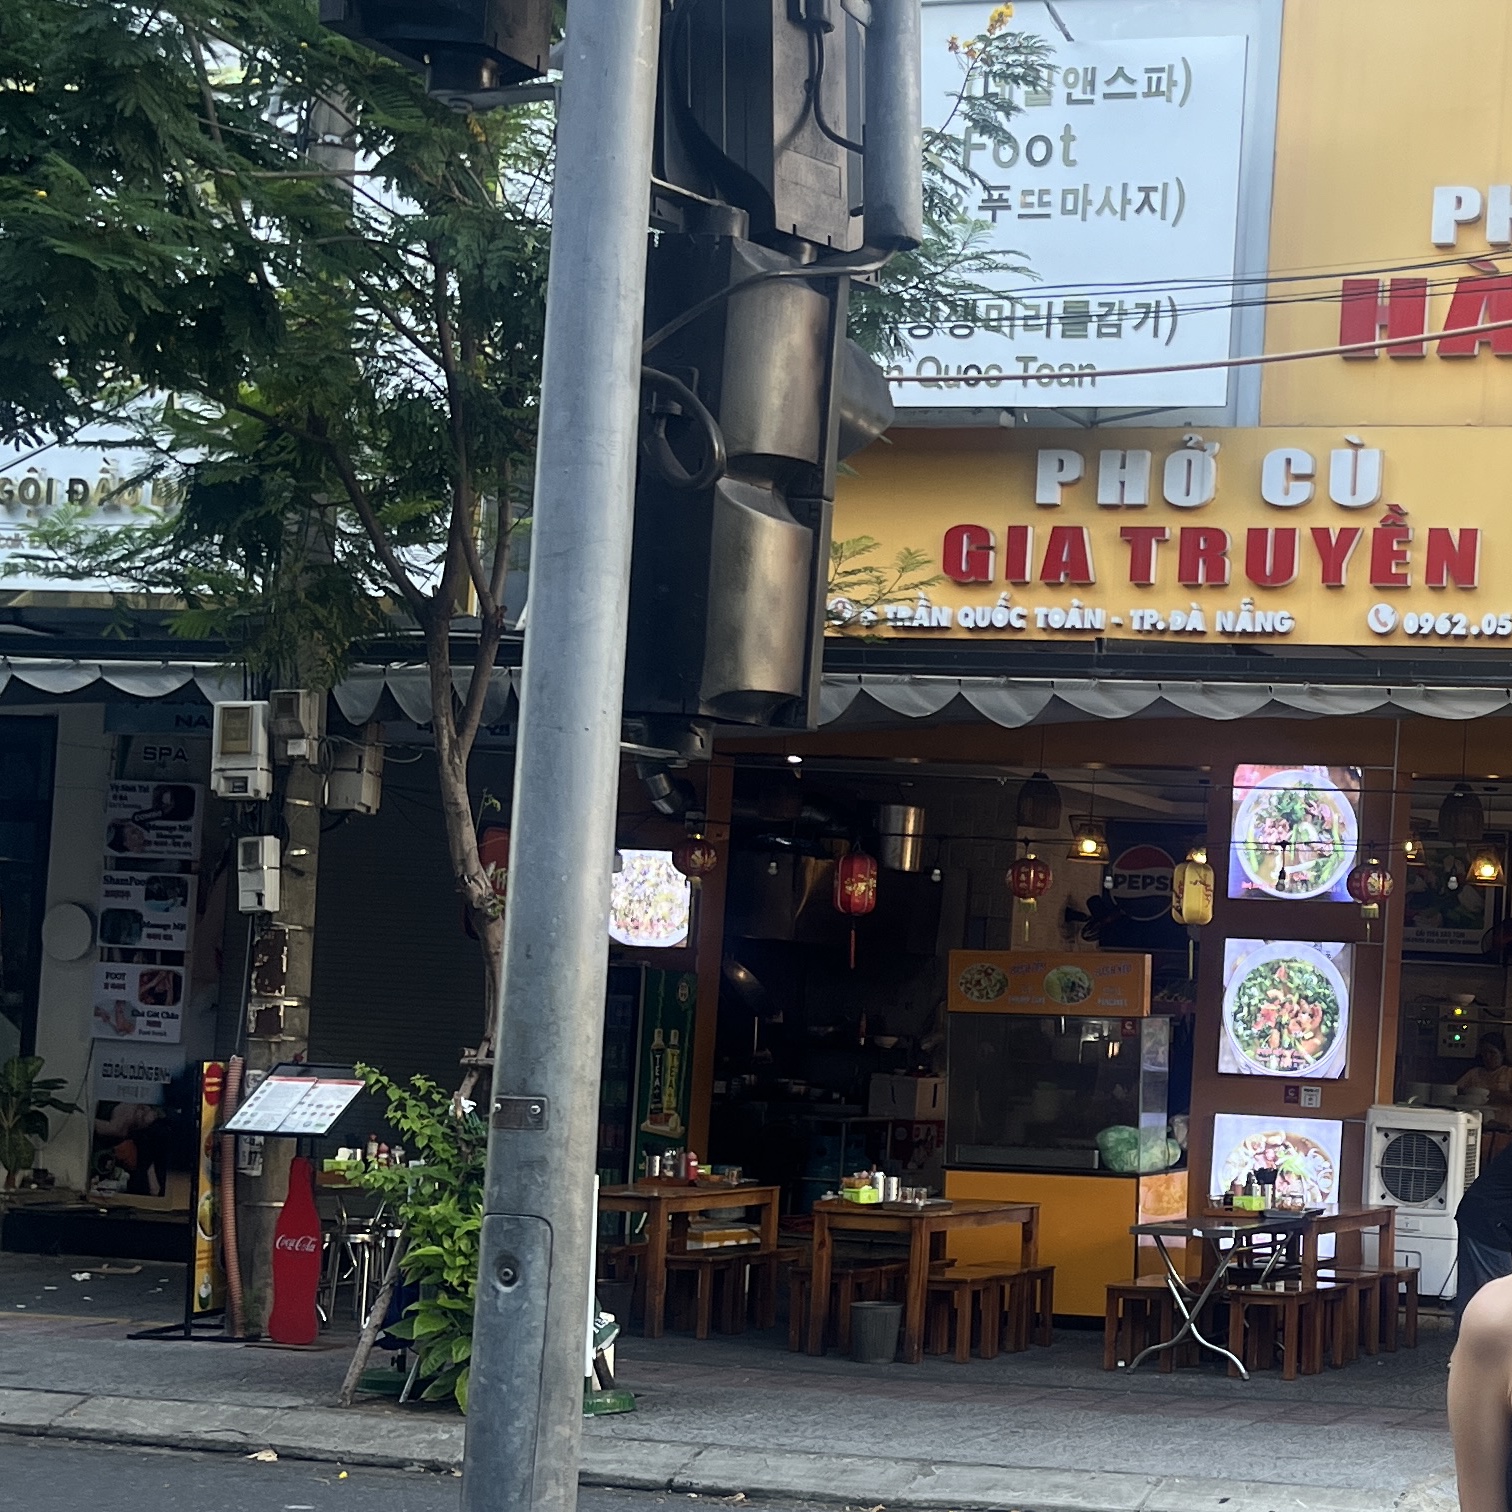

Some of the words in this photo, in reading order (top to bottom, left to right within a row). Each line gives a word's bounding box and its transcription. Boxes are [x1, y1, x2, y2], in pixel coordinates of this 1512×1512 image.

[963, 123, 1077, 169] Foot
[1015, 356, 1097, 388] Toan
[1035, 433, 1221, 508] PHỞ
[1261, 434, 1385, 508] CÙ
[942, 524, 1096, 585] GIA
[1120, 503, 1483, 588] TRUYỀN
[884, 591, 953, 628] TRẦN
[958, 591, 1028, 629] QUỐC
[1034, 598, 1107, 631] TOẢN
[1130, 602, 1208, 633] TP.ĐÀ
[1216, 597, 1296, 634] NẴNG
[143, 746, 189, 762] SPA
